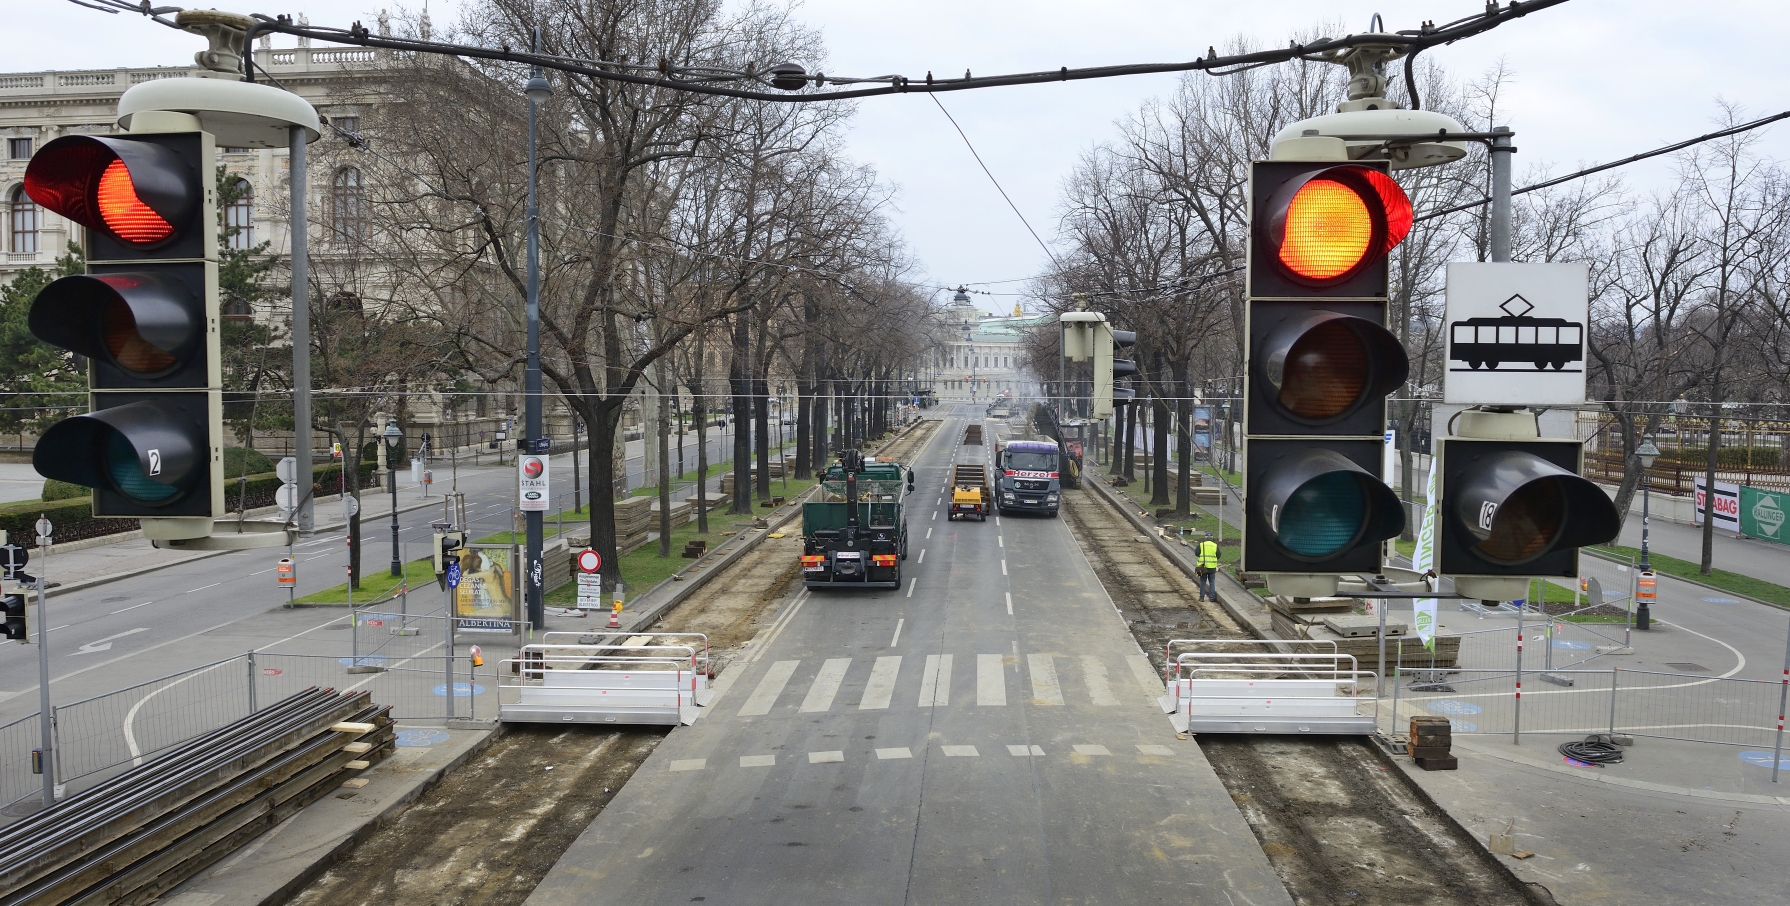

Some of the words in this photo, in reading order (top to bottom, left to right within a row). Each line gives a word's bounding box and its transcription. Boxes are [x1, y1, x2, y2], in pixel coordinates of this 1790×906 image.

[151, 452, 159, 474] 2
[1696, 491, 1737, 515] STABAG
[1482, 503, 1495, 528] 18
[459, 618, 510, 627] ALBERTINA
